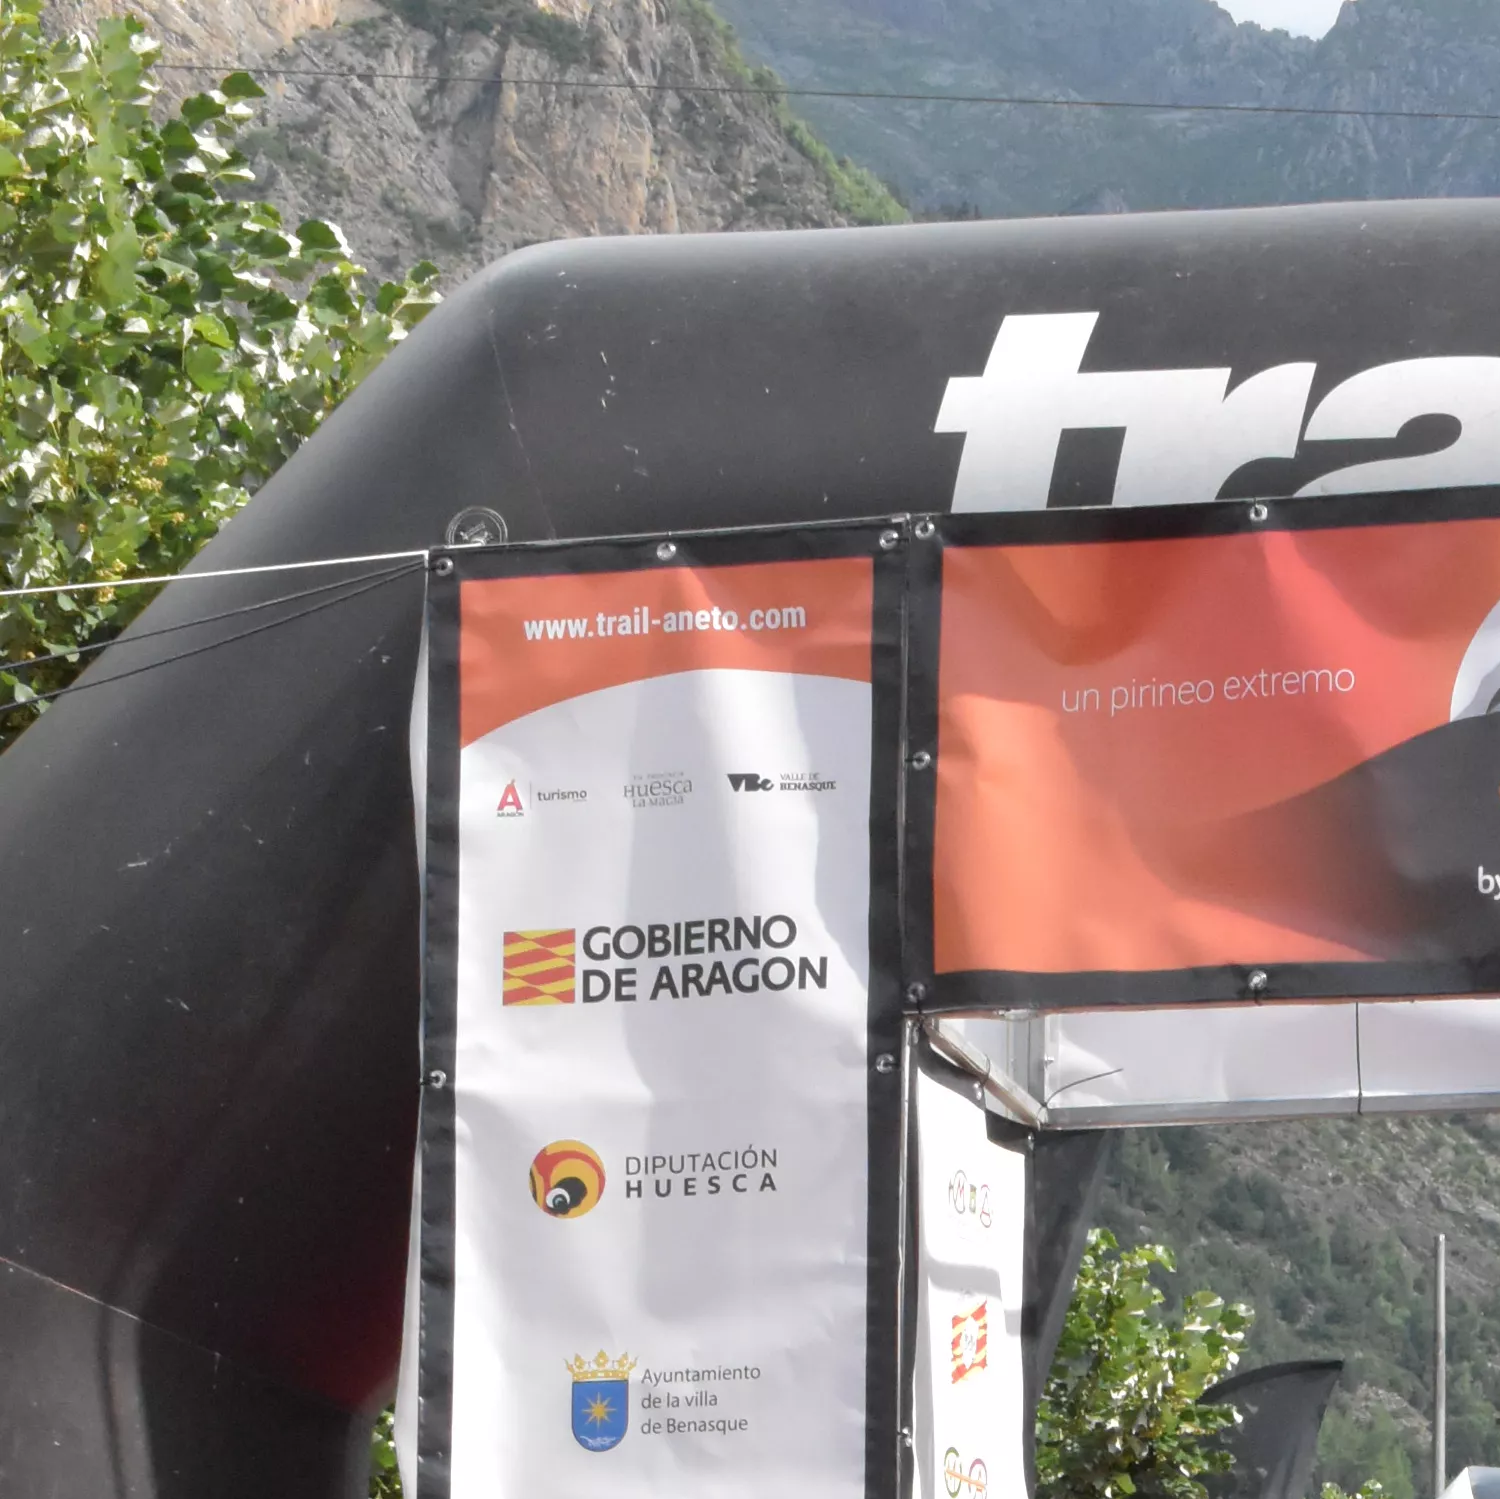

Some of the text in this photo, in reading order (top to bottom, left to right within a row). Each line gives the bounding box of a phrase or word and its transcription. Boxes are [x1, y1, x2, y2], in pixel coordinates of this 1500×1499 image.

[523, 605, 806, 641] www.trail-aneto.com
[1061, 665, 1355, 717] un pirineo extremo
[780, 772, 819, 781] VALLE DE
[780, 781, 836, 791] BENASQUE
[537, 788, 588, 803] turismo
[582, 914, 797, 961] GOBIERNO
[582, 957, 828, 1004] DE ARAGON
[625, 1144, 778, 1176] DIPUTACIÓN
[626, 1173, 778, 1198] HUESCA
[641, 1363, 761, 1387] Ayuntamiento
[641, 1390, 718, 1409] de la villa
[640, 1416, 748, 1437] de Benasque
